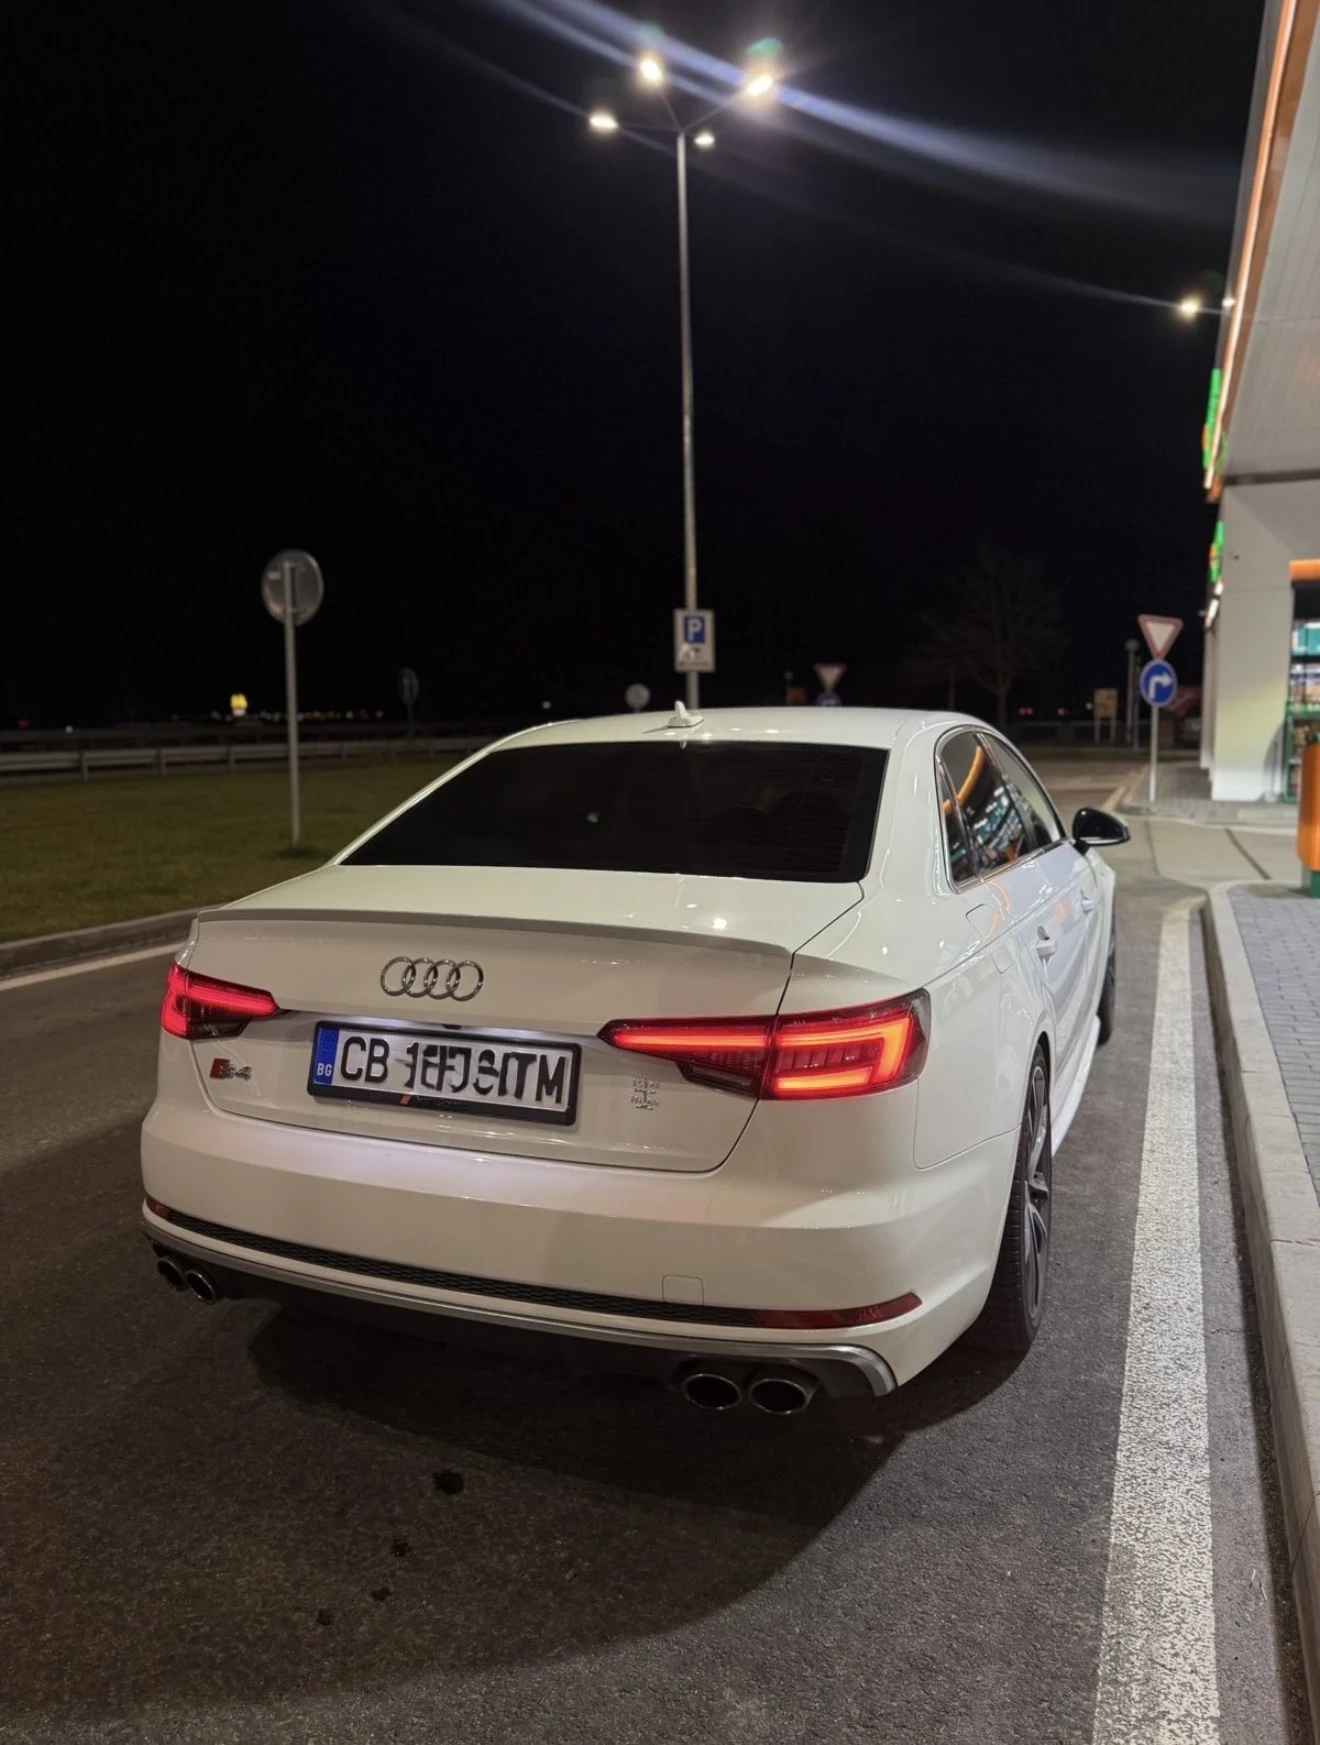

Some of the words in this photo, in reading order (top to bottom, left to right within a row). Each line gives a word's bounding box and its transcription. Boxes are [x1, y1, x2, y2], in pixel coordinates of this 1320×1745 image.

[688, 618, 703, 642] P
[316, 1063, 333, 1077] BG
[341, 1035, 390, 1083] CB
